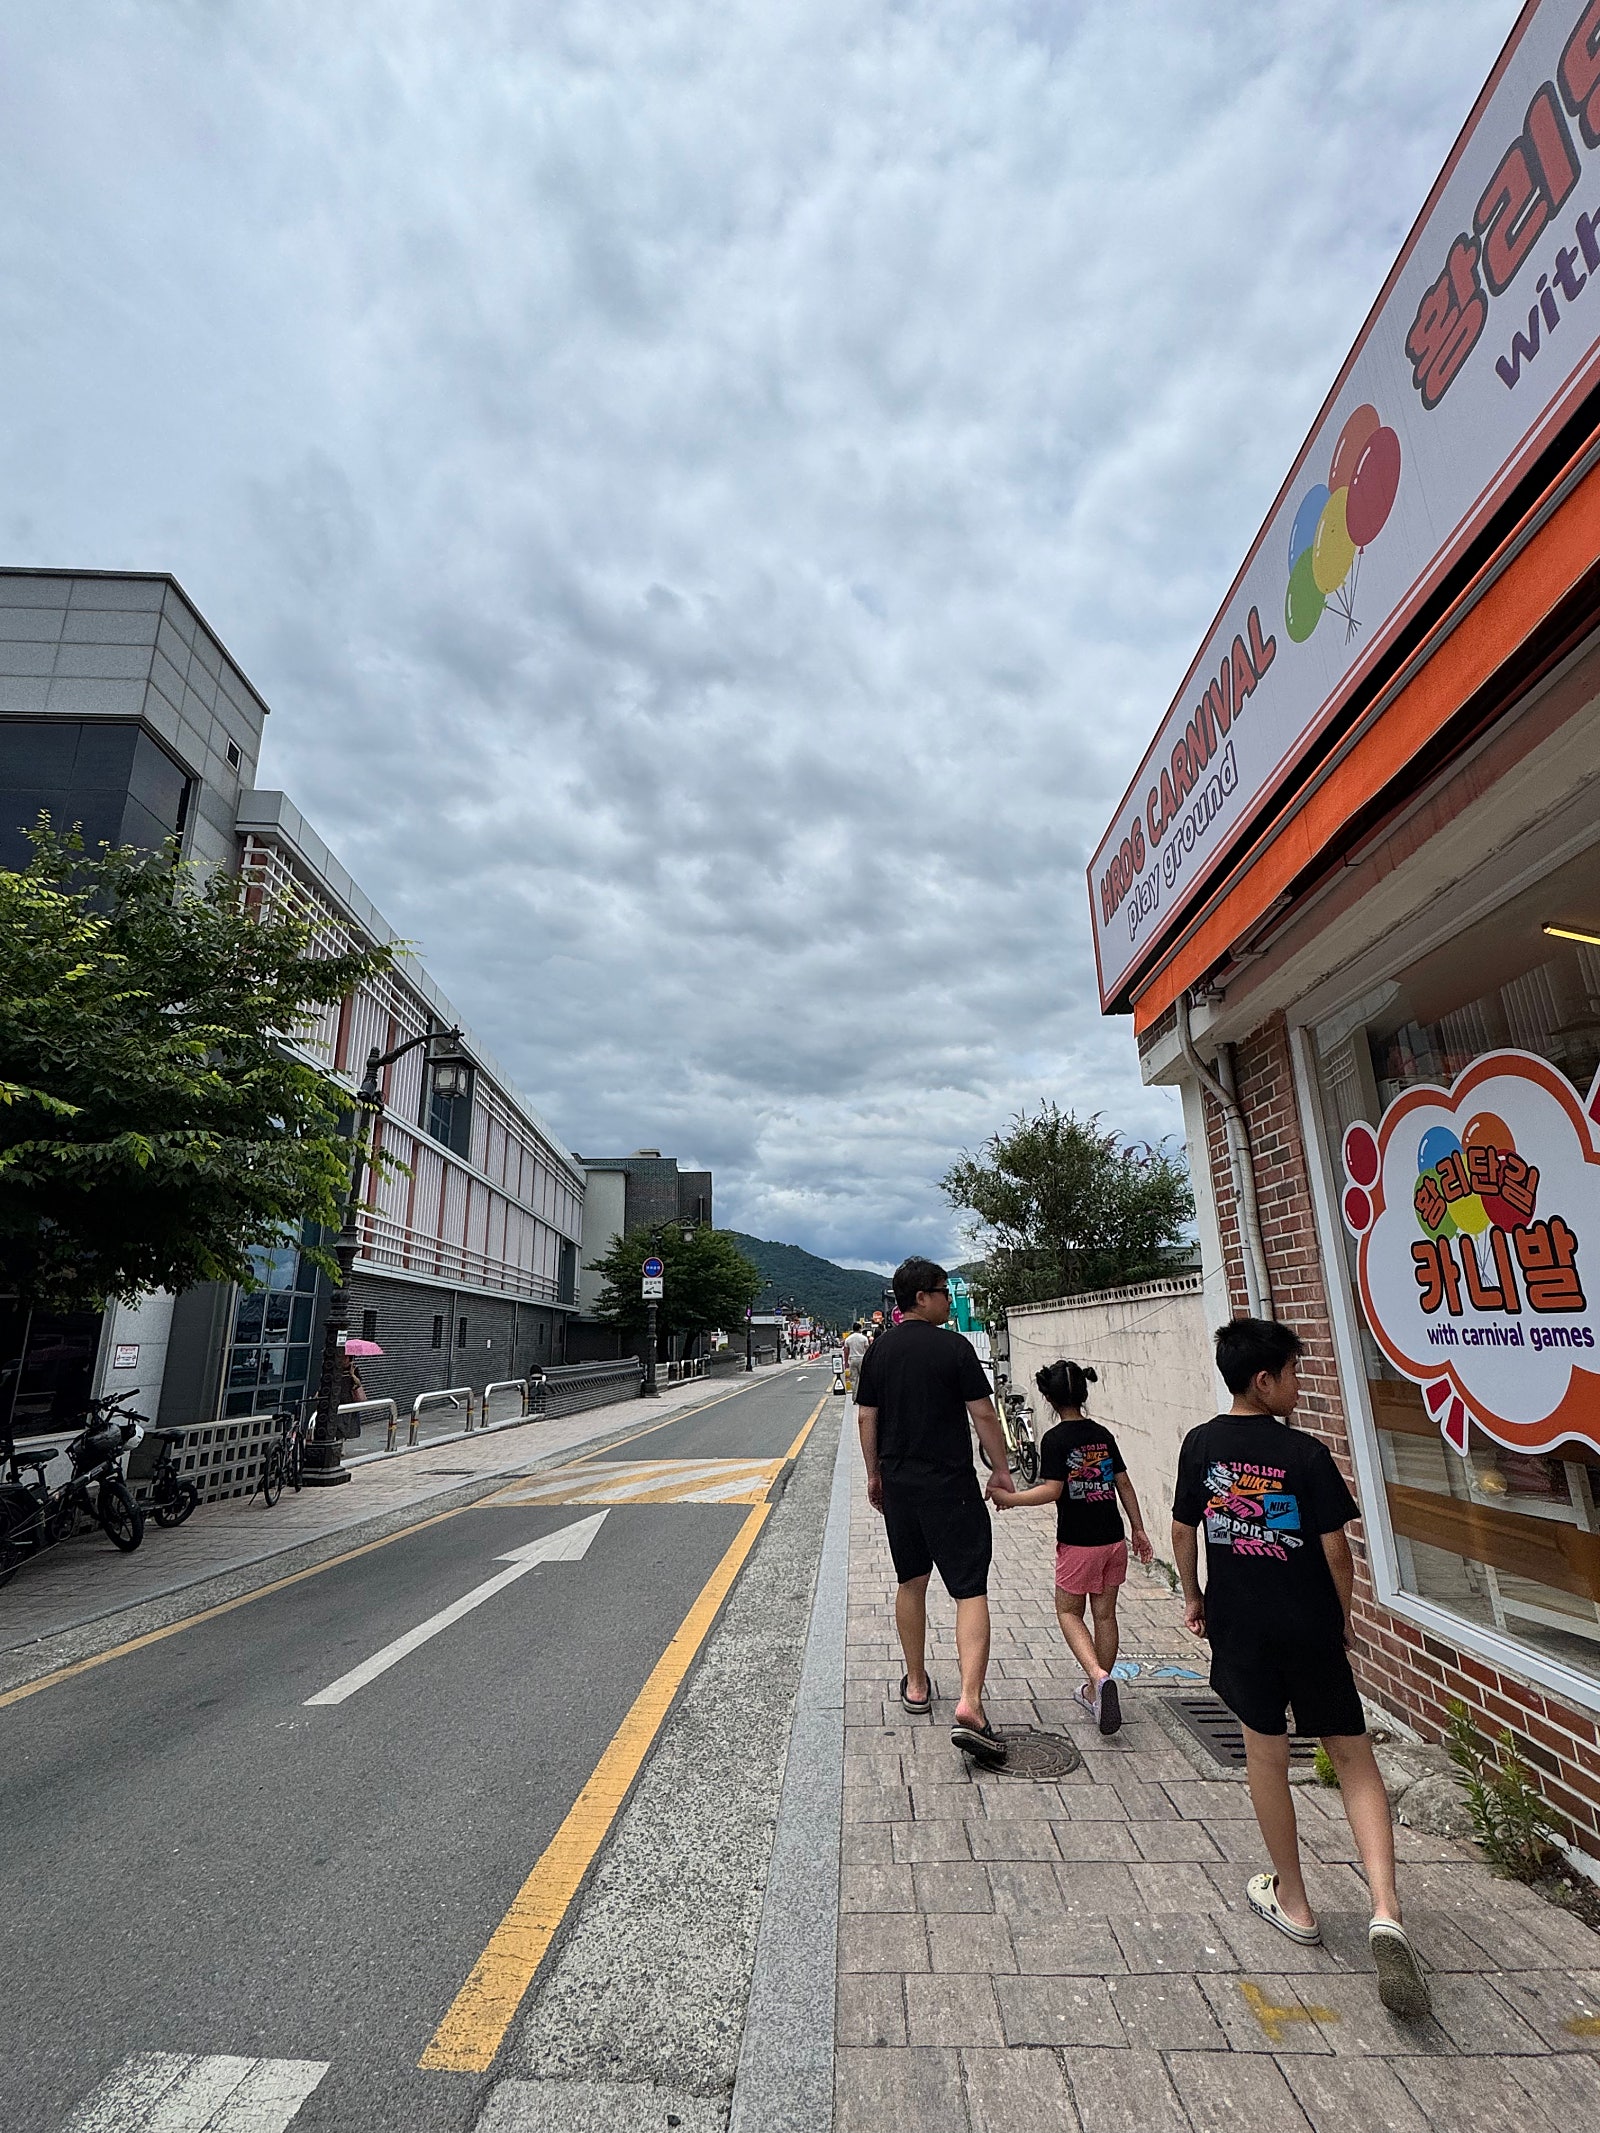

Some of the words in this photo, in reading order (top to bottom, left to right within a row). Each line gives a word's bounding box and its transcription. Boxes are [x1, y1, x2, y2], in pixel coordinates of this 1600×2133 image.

[1147, 605, 1277, 848] CARNIVAL
[1127, 863, 1160, 942] play
[1163, 740, 1239, 889] ground
[1414, 1145, 1540, 1230] 황리단길
[1411, 1214, 1587, 1317] 카니발
[1427, 1323, 1459, 1345] with
[1462, 1322, 1525, 1346] carnival
[1530, 1326, 1595, 1351] games
[1238, 1473, 1272, 1489] NIKE
[1243, 1463, 1260, 1475] DO
[1261, 1465, 1287, 1478] JUST
[1270, 1502, 1291, 1512] NIKE
[1211, 1513, 1231, 1529] JUST
[1232, 1520, 1249, 1534] DO
